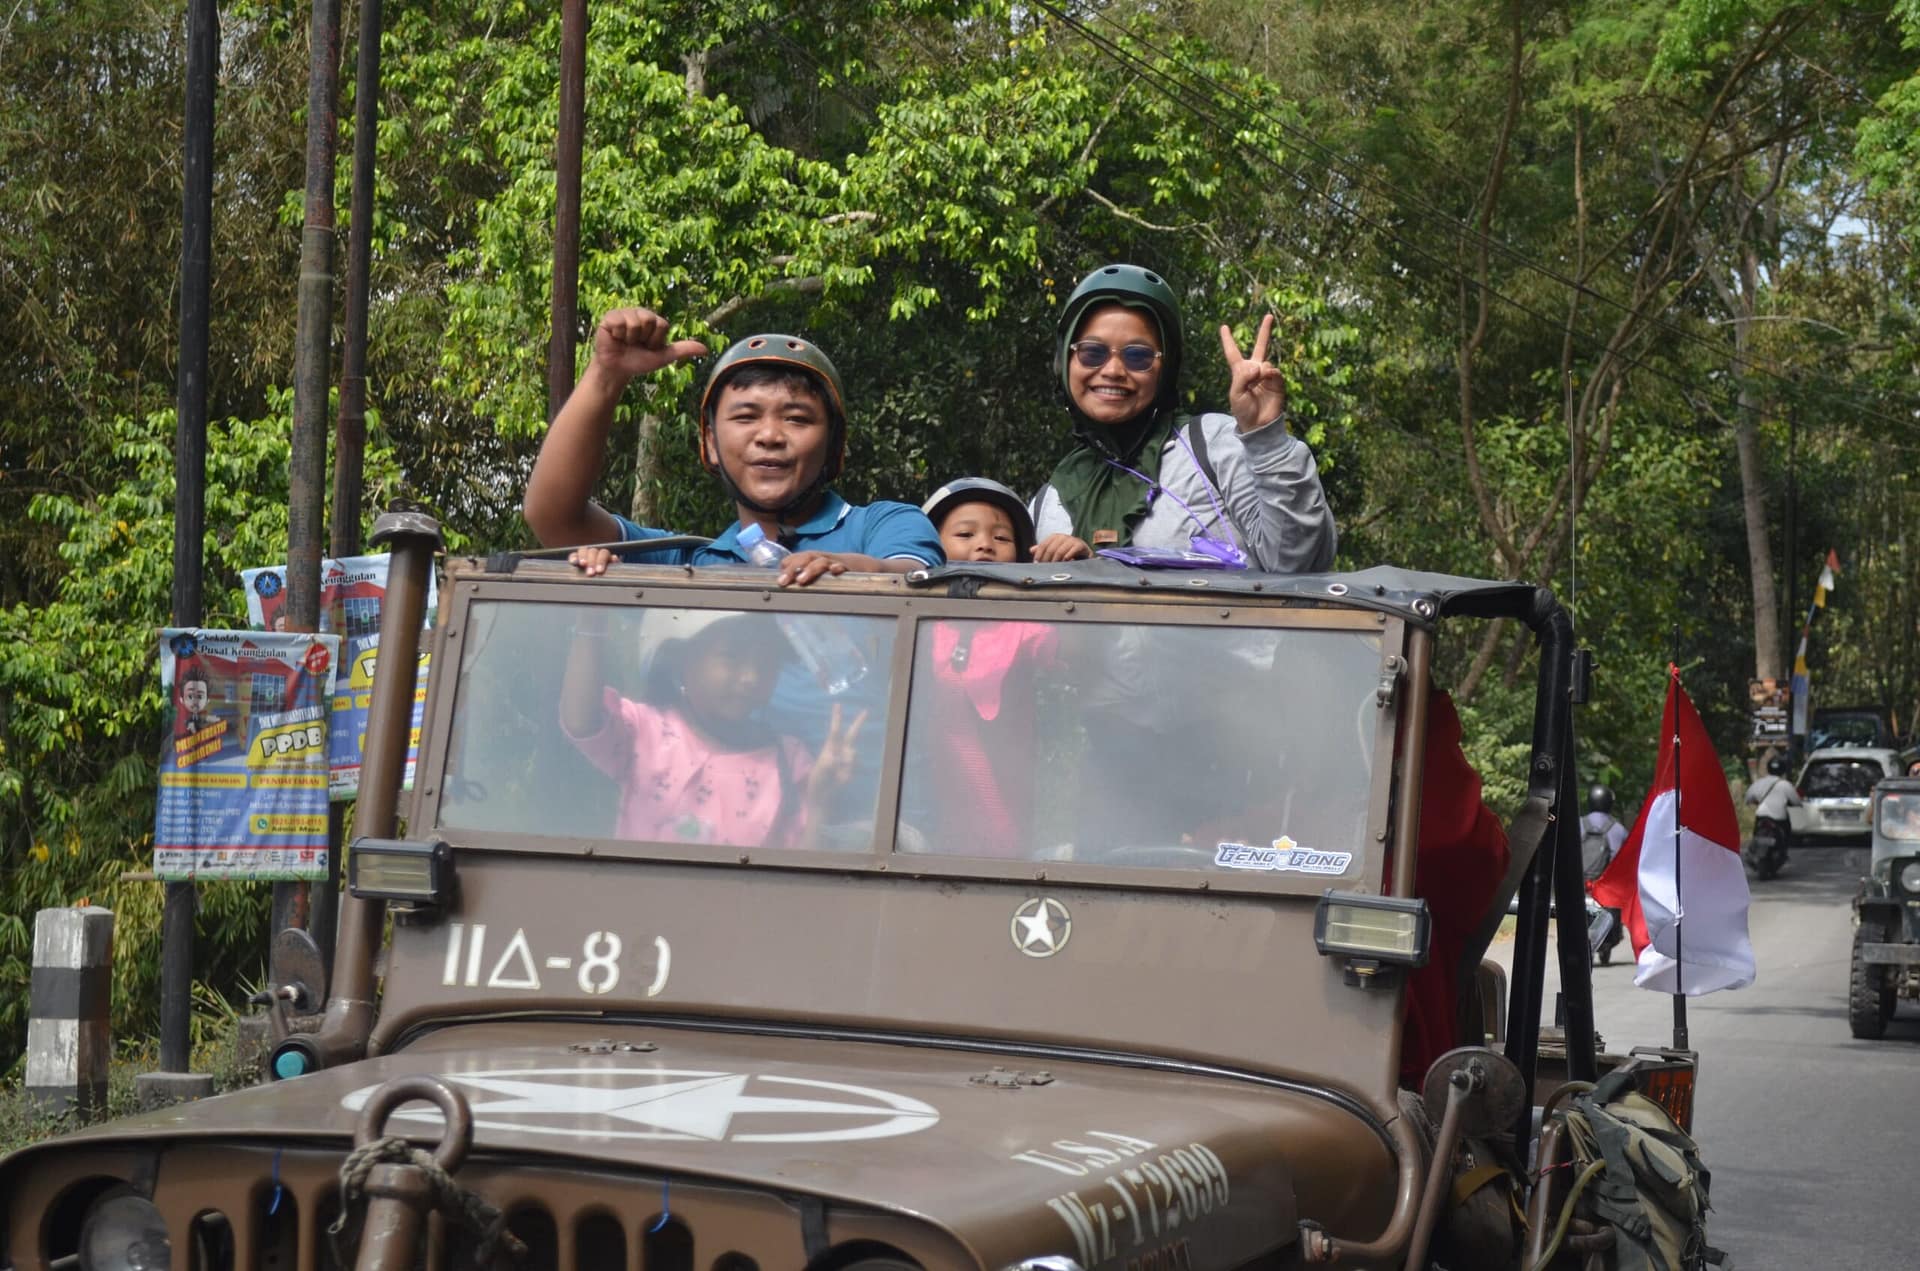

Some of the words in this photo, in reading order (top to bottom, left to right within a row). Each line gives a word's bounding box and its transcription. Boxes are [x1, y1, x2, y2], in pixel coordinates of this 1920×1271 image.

[321, 571, 377, 585] eunggulan
[201, 645, 228, 655] Pusat
[231, 647, 288, 658] Keunggulan
[261, 726, 323, 758] PPDB
